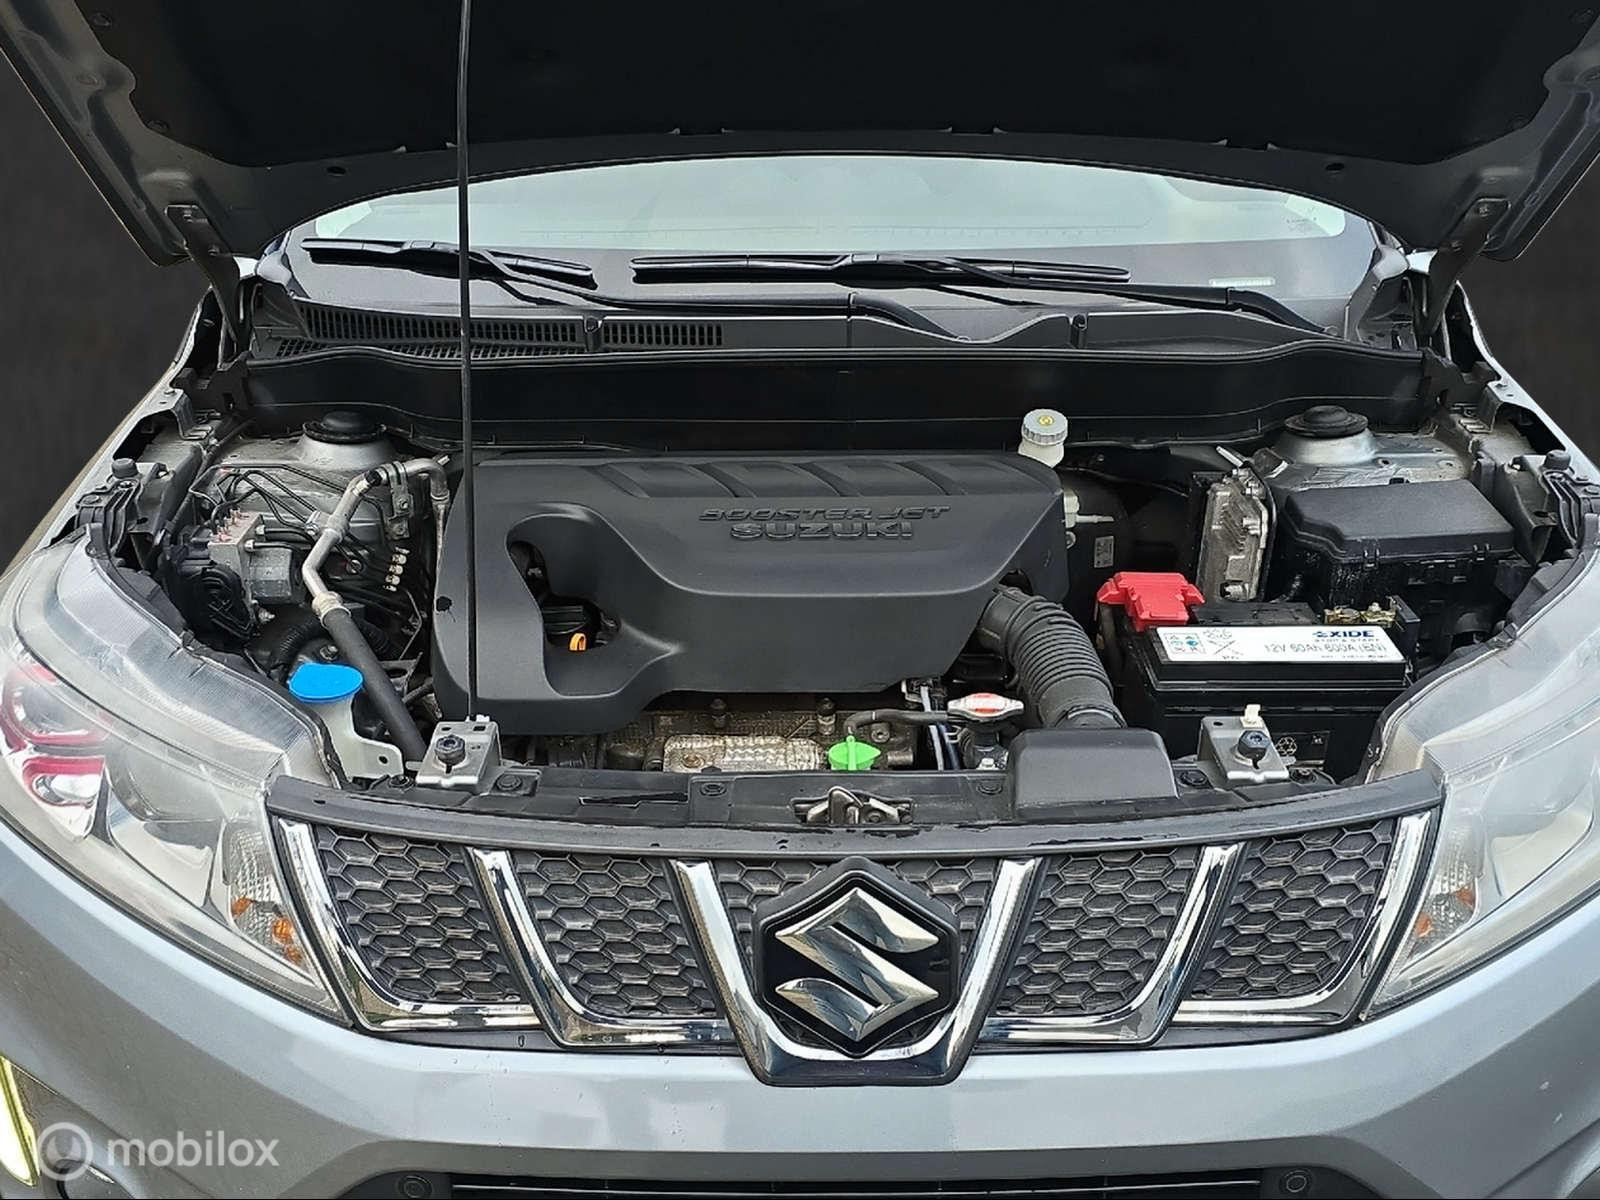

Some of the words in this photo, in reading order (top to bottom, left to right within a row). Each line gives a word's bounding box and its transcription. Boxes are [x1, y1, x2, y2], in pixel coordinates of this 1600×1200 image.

[730, 521, 913, 539] SUZUKI
[1312, 630, 1375, 638] EXIDE
[1264, 643, 1286, 653] 12V
